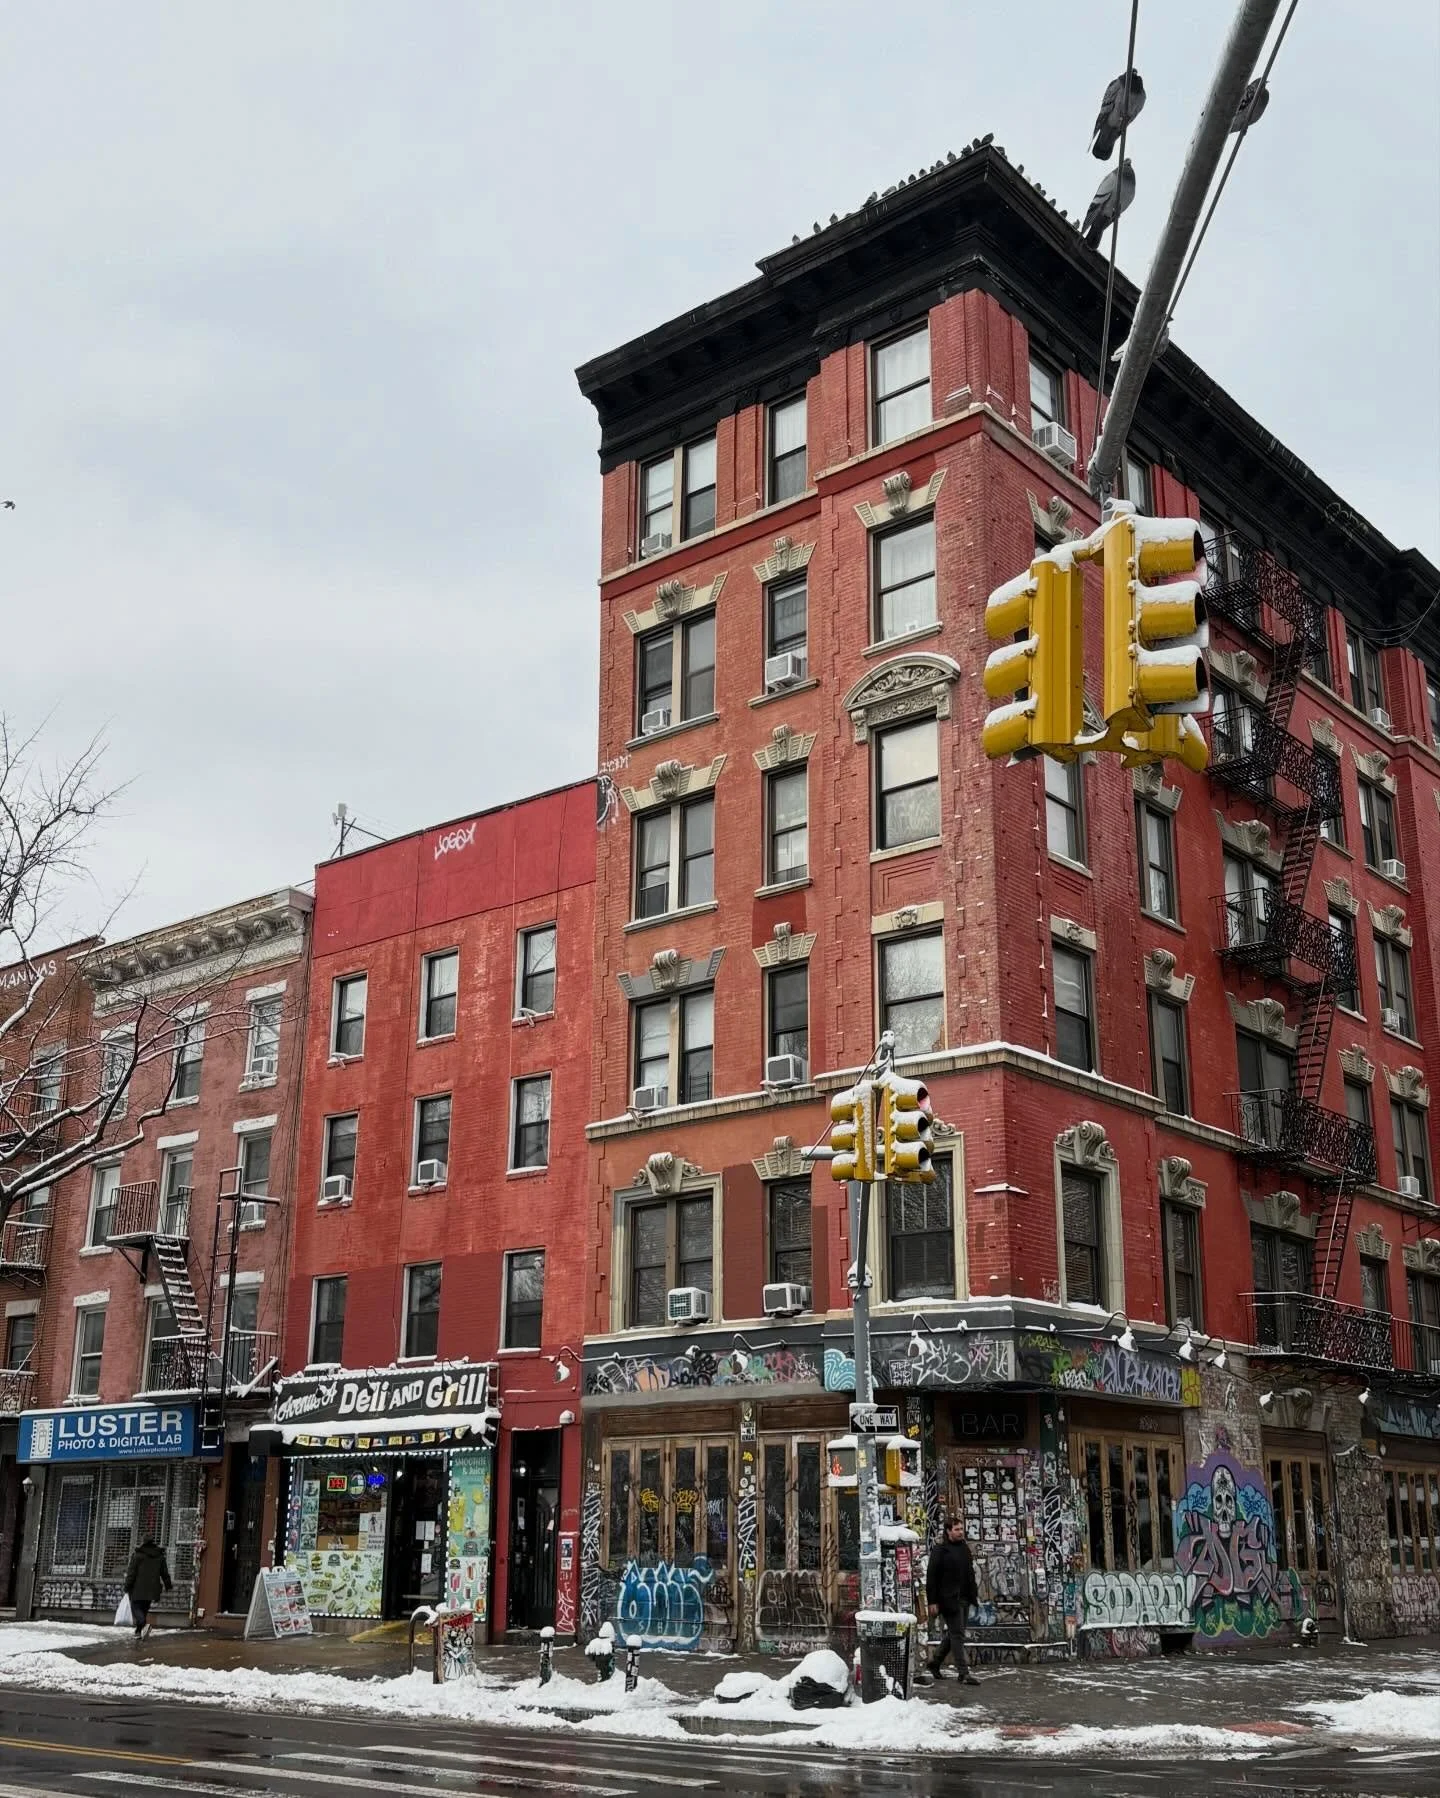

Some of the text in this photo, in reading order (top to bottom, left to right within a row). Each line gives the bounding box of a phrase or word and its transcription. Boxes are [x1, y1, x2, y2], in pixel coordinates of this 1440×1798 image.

[338, 1380, 390, 1415] Deli
[388, 1379, 424, 1410] AND
[425, 1373, 486, 1409] Grill
[58, 1410, 183, 1438] LUSTER
[860, 1413, 894, 1425] ONE WAY
[961, 1412, 1019, 1436] BAR
[57, 1434, 182, 1450] PHOTO & DIGITAL LAB
[882, 1506, 891, 1520] A
